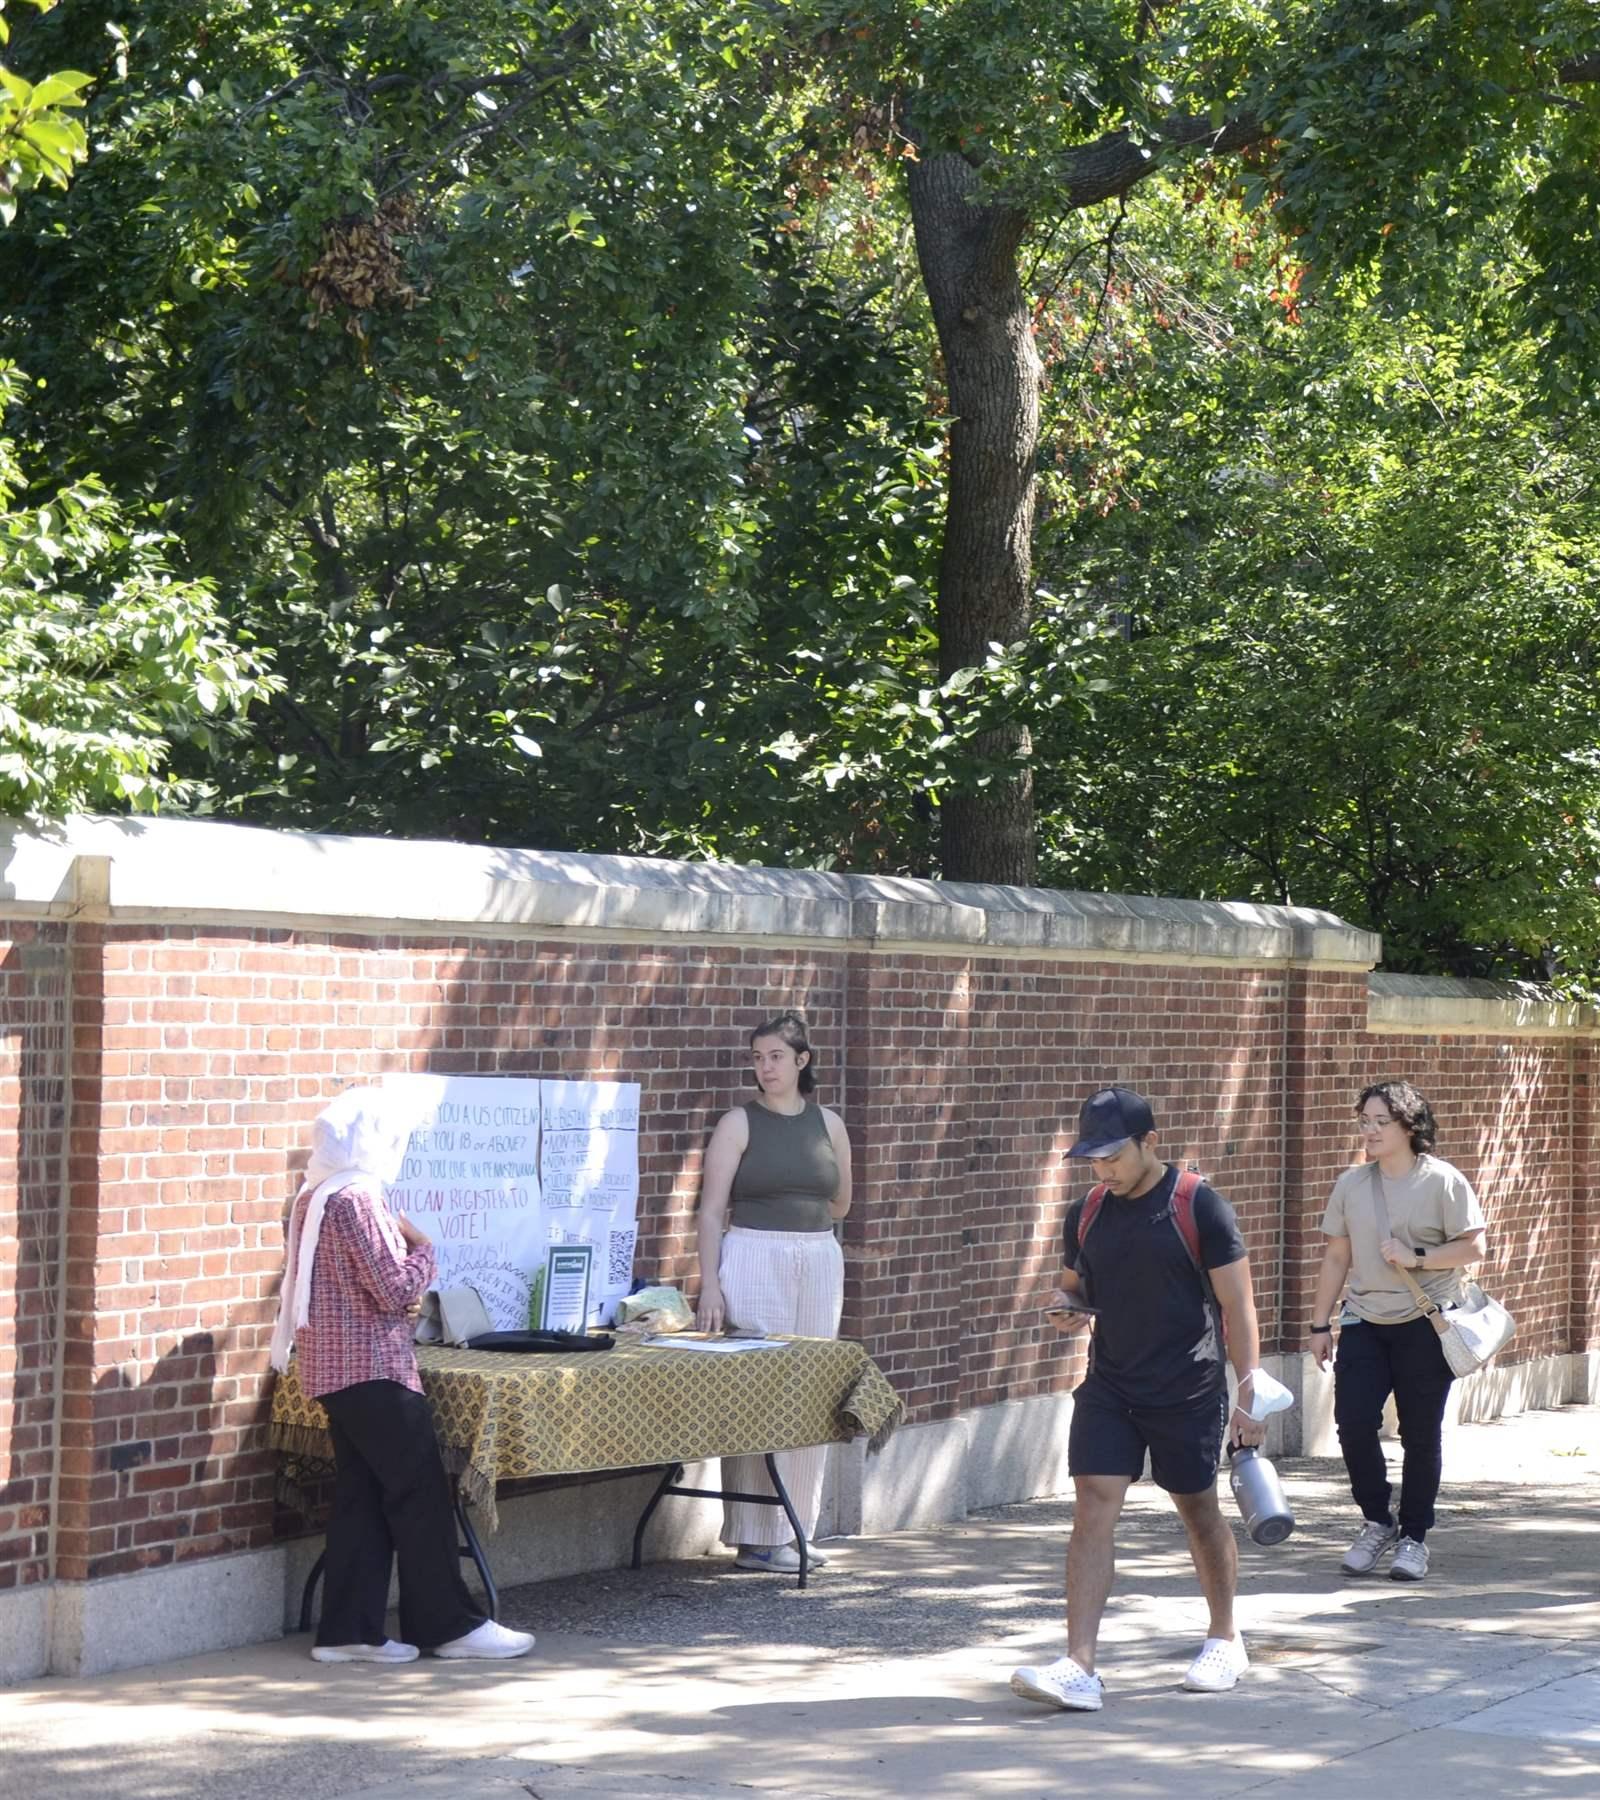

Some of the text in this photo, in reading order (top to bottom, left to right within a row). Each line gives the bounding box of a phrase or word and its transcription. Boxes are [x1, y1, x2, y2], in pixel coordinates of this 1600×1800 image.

[437, 1102, 460, 1124] YOU
[434, 1131, 455, 1151] YOU
[427, 1159, 447, 1179] YOU
[384, 1187, 528, 1213] YOU CAN REGISTER TO
